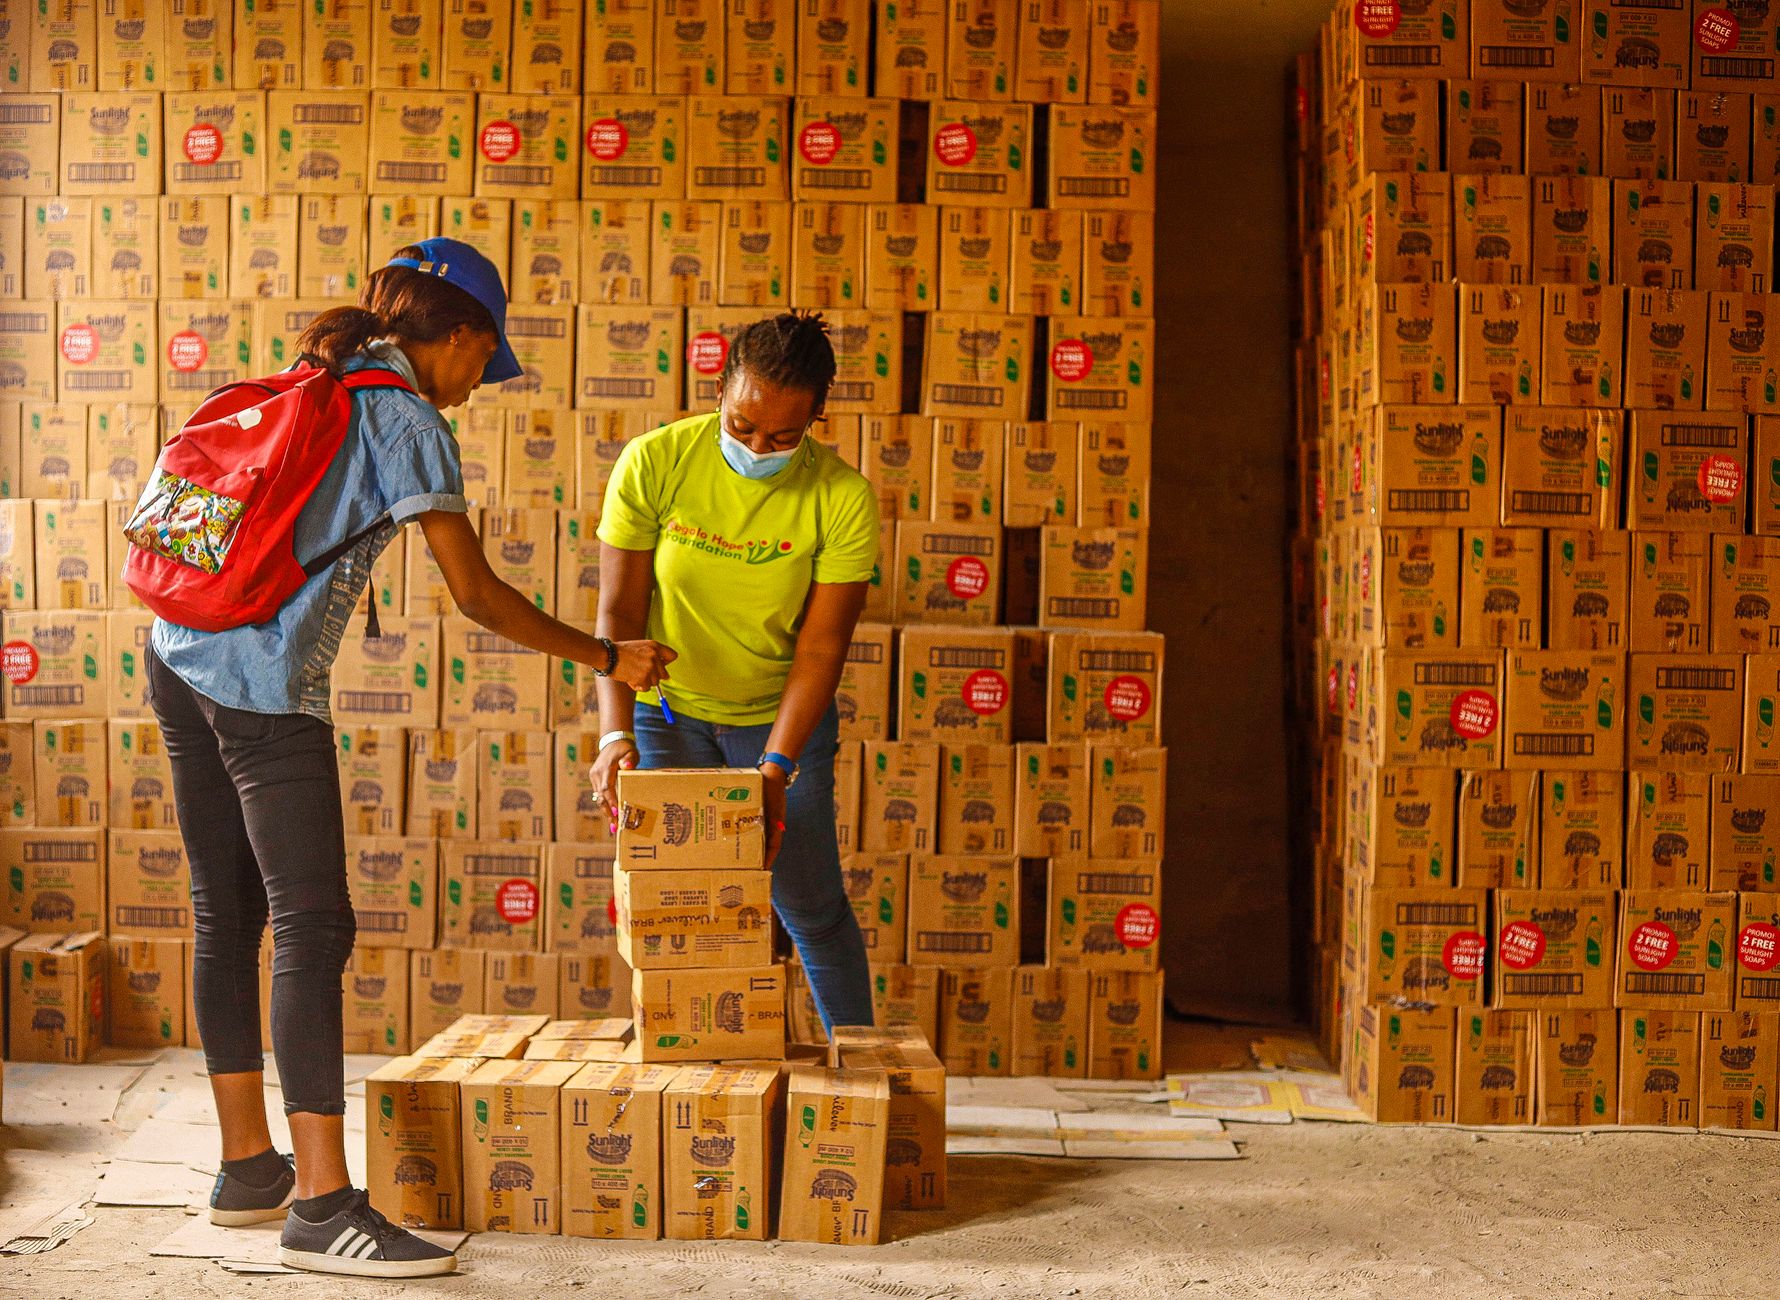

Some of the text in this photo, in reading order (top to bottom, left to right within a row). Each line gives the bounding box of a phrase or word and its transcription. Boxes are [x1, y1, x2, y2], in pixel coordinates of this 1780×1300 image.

[1363, 6, 1393, 15] 2 FREE
[1707, 12, 1733, 27] PROMO!
[1702, 19, 1732, 38] 2 FREE
[1699, 28, 1729, 45] SUNLIGHT
[1700, 36, 1720, 50] SOAPS
[86, 314, 126, 327] Sunlight
[1415, 422, 1464, 438] Sunlight
[1541, 425, 1588, 442] Sunlight
[1706, 475, 1738, 490] 2 FREE
[665, 530, 743, 560] Foundation
[712, 533, 744, 550] Hope
[1542, 667, 1589, 681] Sunlight
[1458, 710, 1483, 725] FREE
[662, 802, 676, 845] Sunlight
[658, 914, 710, 927] Unilever
[1654, 907, 1703, 922] Sunlight
[1640, 926, 1670, 939] PROMO!
[1746, 927, 1775, 940] PROMO!
[1505, 932, 1537, 950] 2 FREE
[1636, 933, 1669, 951] 2 FREE
[1742, 936, 1776, 951] 2 FREE
[1633, 944, 1666, 959] SUNLIGHT
[1740, 947, 1773, 959] SUNLIGHT
[1452, 955, 1477, 966] FREE
[1637, 954, 1659, 965] SOAPS
[1744, 955, 1766, 966] SOAPS
[731, 992, 745, 1034] Sunlight
[1721, 1046, 1756, 1058] Sunlight
[504, 1087, 513, 1126] BRAND
[589, 1133, 633, 1148] Sunlight
[692, 1136, 736, 1151] Sunlight
[489, 1178, 532, 1192] Sunlight
[809, 1186, 855, 1202] Sunlight
